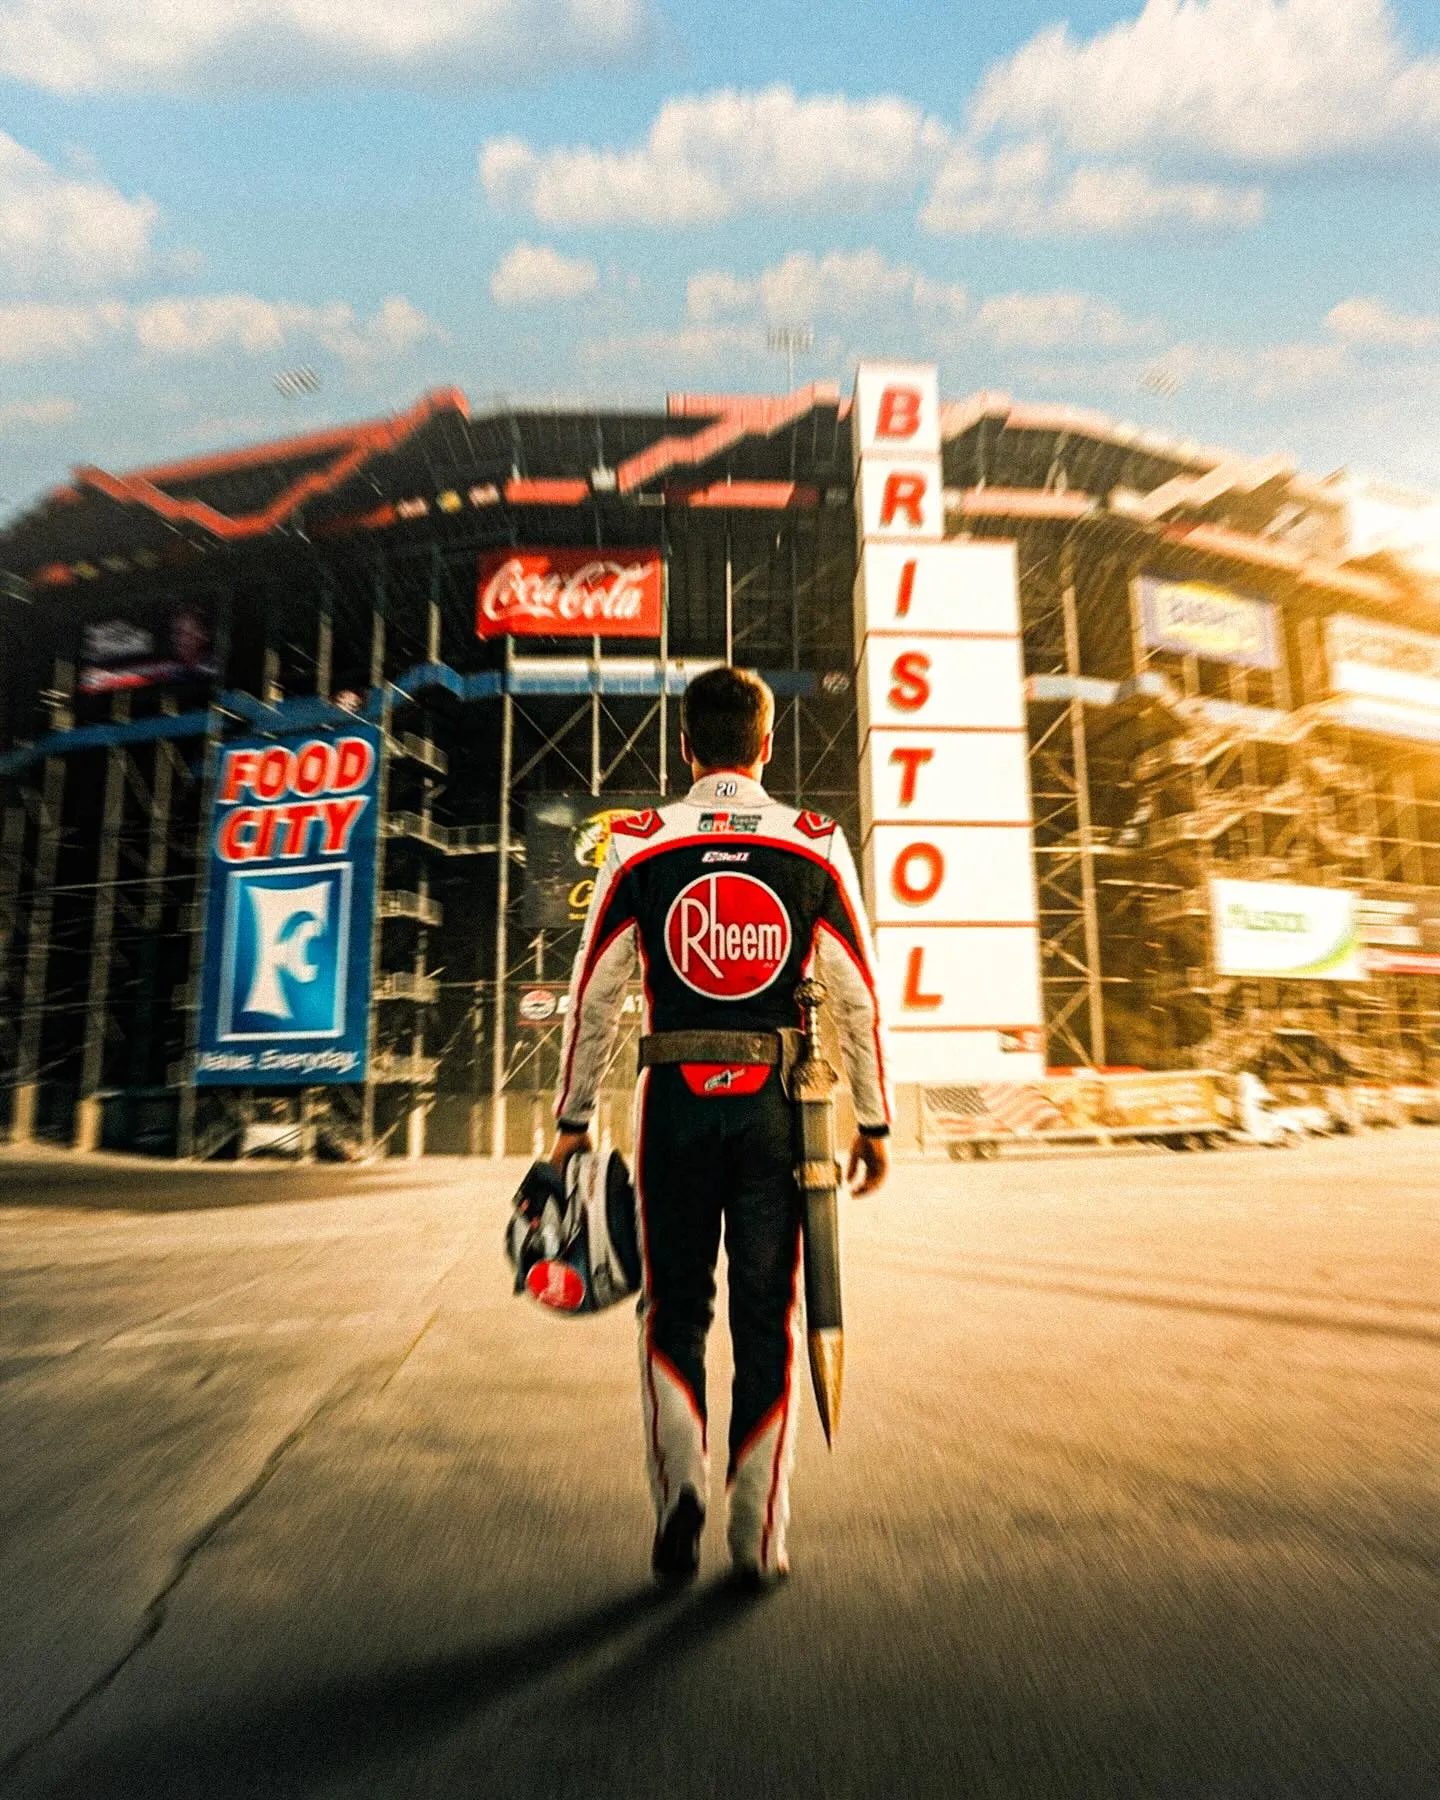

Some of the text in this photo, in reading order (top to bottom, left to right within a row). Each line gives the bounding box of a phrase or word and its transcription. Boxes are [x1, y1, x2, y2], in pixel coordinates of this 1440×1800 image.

[876, 384, 945, 1009] BRISTOL
[214, 737, 375, 804] FOOD
[715, 782, 737, 798] 20
[216, 796, 370, 863] CITY
[680, 876, 782, 979] Rheem
